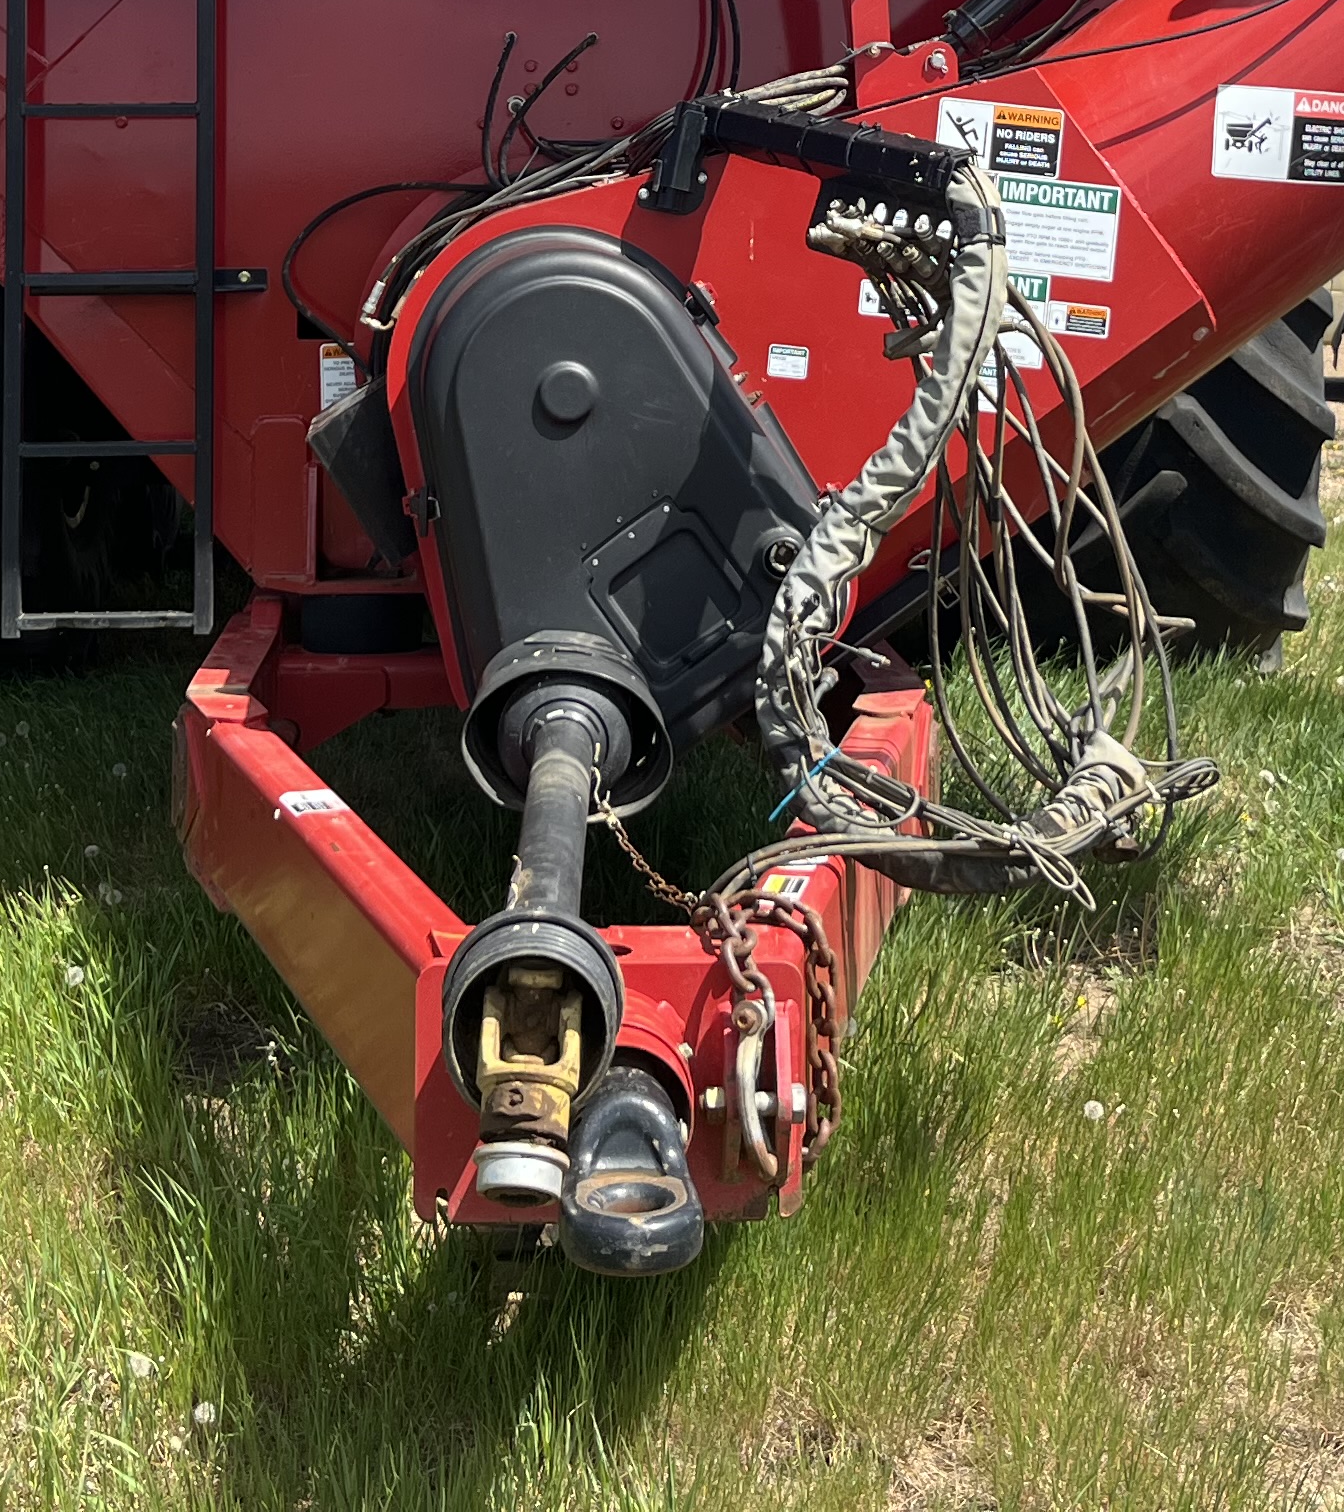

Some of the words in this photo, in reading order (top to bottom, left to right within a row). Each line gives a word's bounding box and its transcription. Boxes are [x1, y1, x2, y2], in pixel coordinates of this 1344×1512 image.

[1008, 112, 1059, 125] WARNING
[996, 128, 1013, 139] NO
[1015, 130, 1056, 143] RIDERS
[1002, 181, 1113, 211] IMPORTANT
